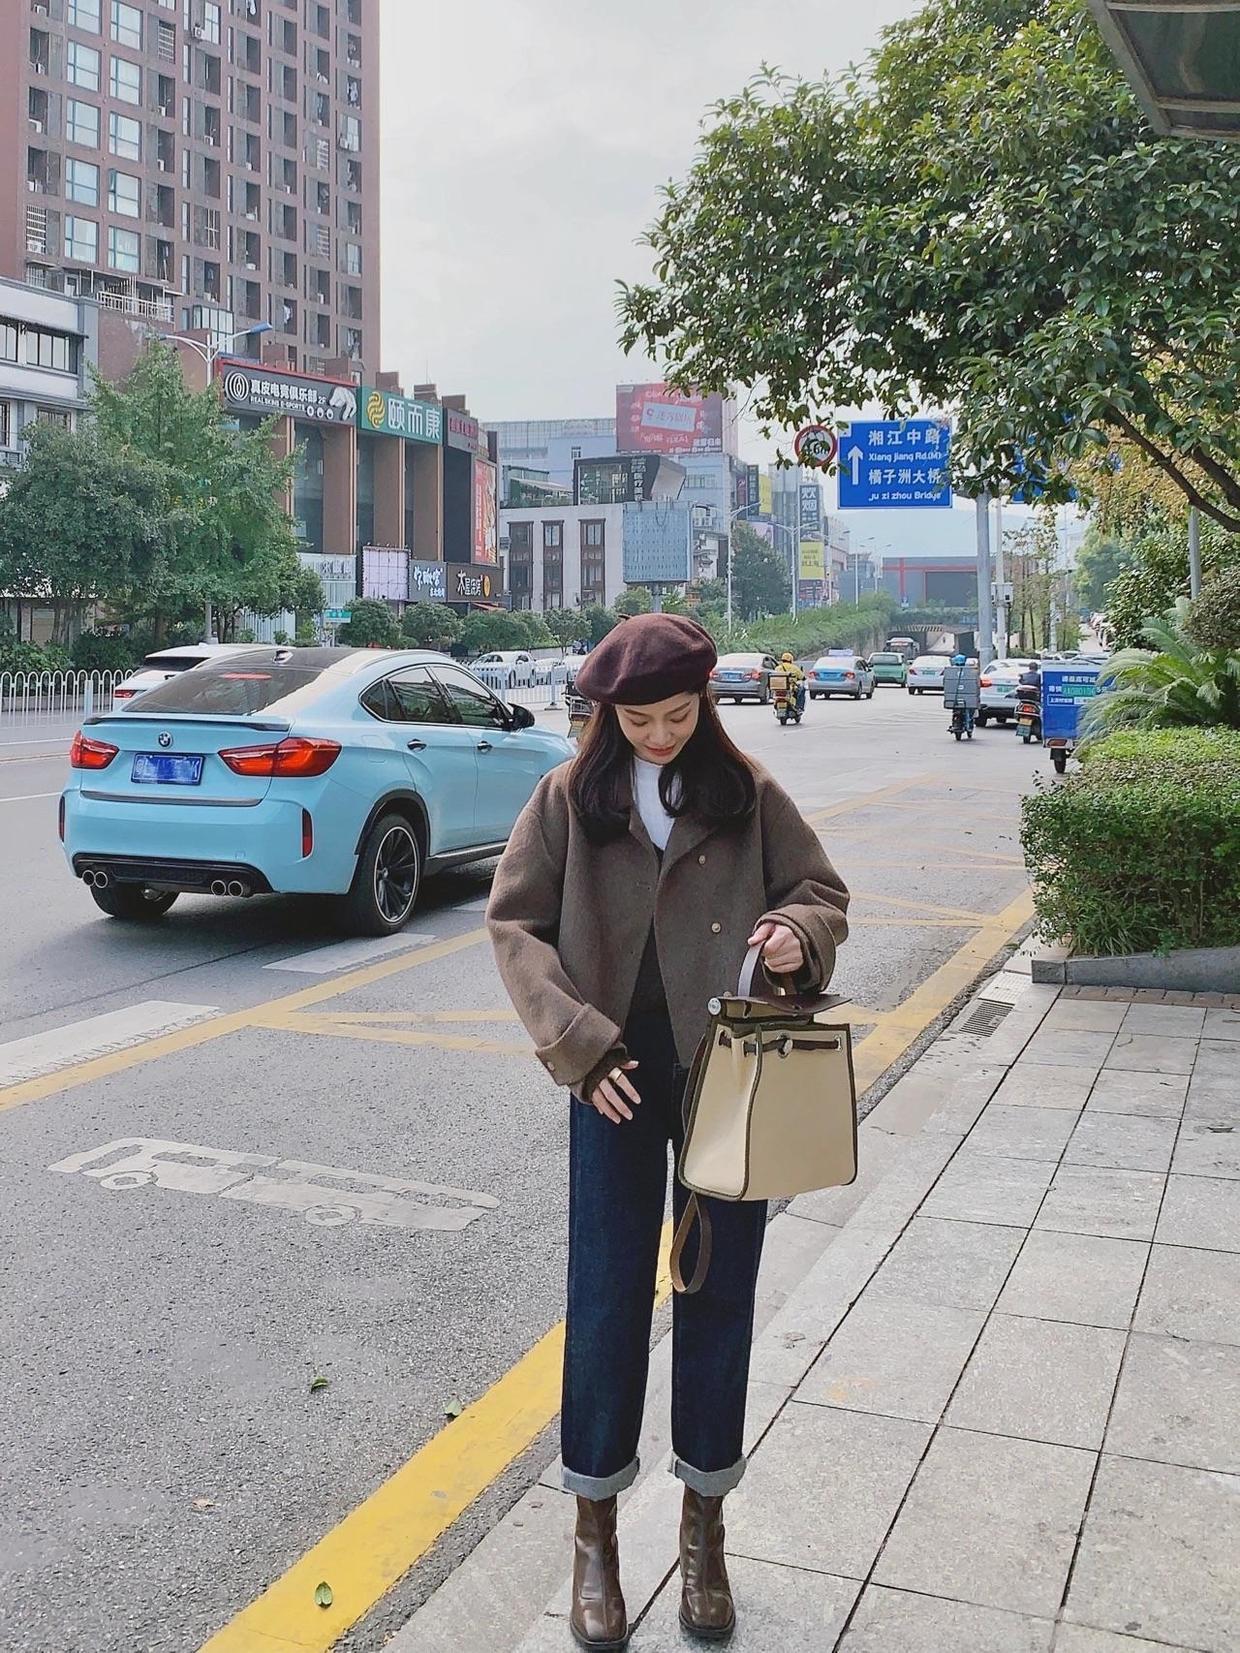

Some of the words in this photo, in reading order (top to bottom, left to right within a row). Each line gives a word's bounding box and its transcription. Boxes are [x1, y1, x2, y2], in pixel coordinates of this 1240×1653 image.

[387, 397, 440, 439] 颐而康
[868, 429, 941, 446] 湘江中路
[868, 453, 892, 463] Xiang
[868, 468, 942, 485] 橘子洲大桥
[891, 491, 912, 500] zhou
[914, 491, 942, 501] Bridge
